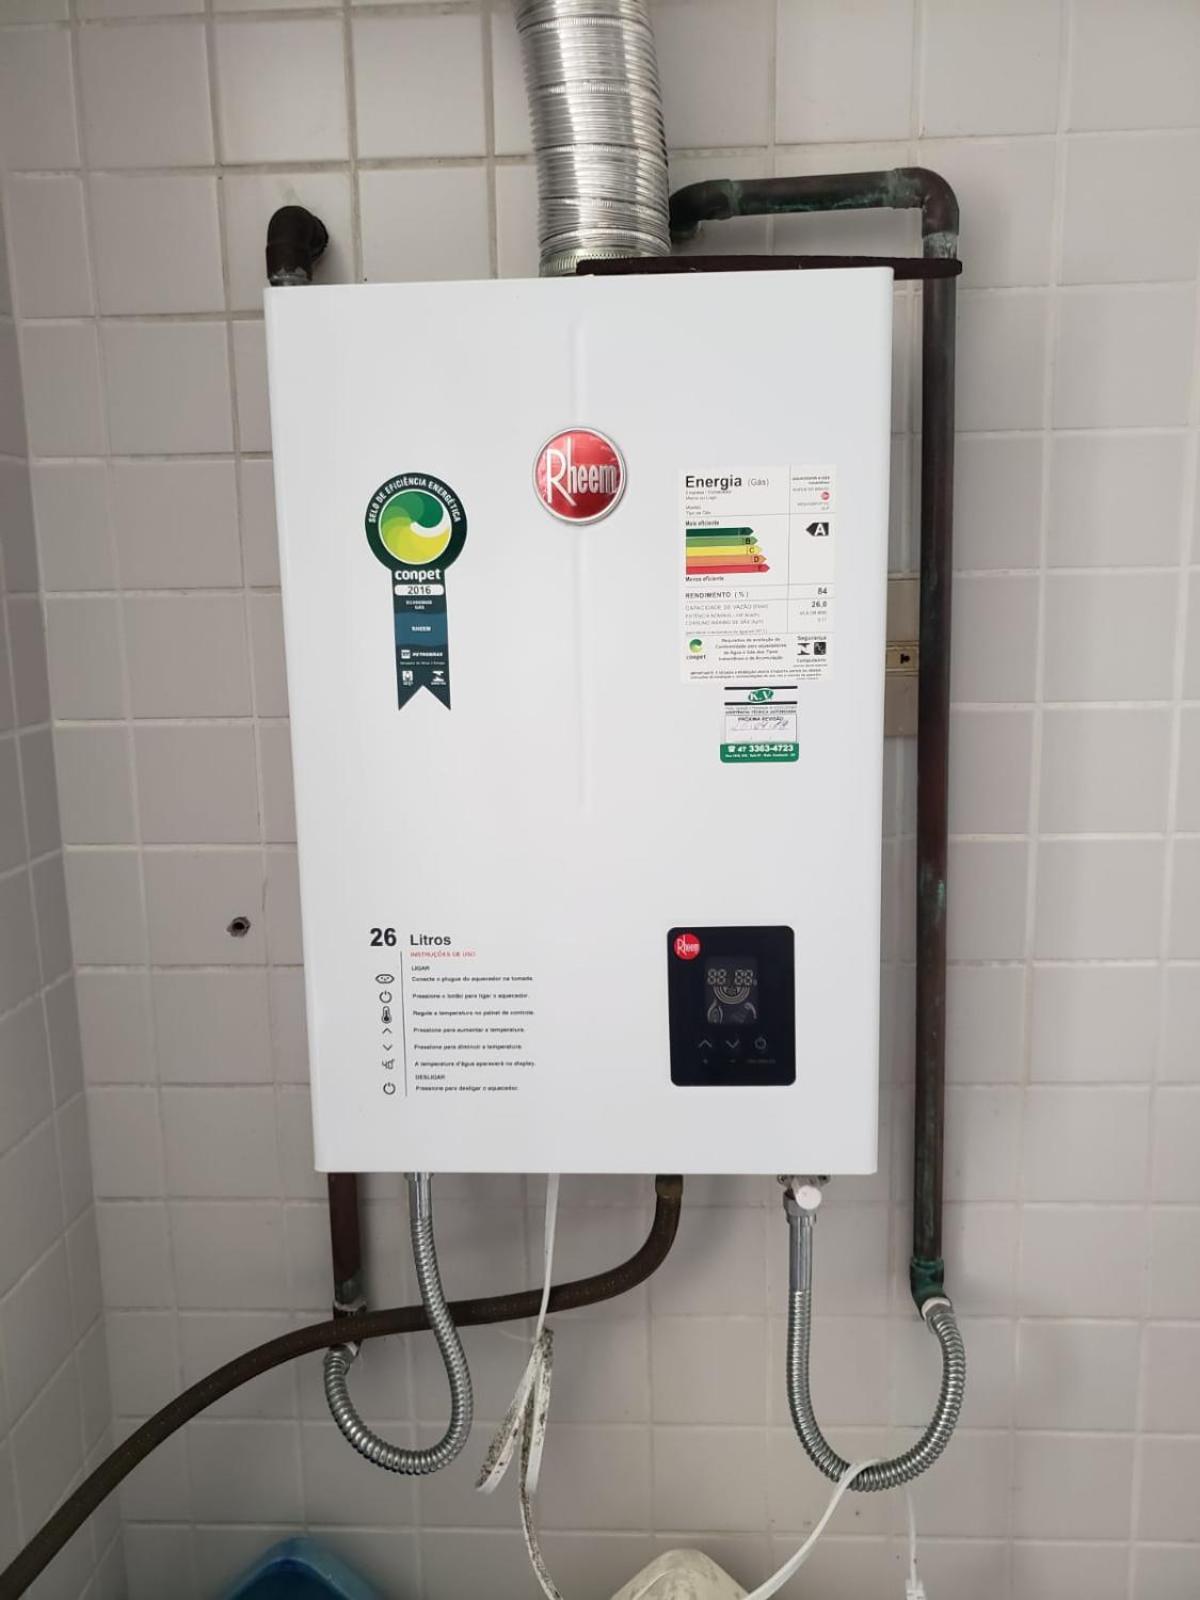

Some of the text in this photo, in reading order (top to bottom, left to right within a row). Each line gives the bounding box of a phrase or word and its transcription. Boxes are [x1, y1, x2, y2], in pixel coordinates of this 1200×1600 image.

[546, 437, 617, 506] Rheem
[685, 474, 742, 490] Energia
[368, 476, 461, 523] SELO DE EFICIÊNCIA ENERGÉTICA
[814, 523, 826, 536] A
[394, 568, 441, 583] conpet
[407, 585, 432, 595] 2016
[748, 744, 794, 753] 3363-4723
[369, 927, 452, 947] 26 Litros
[675, 934, 700, 956] Rheem
